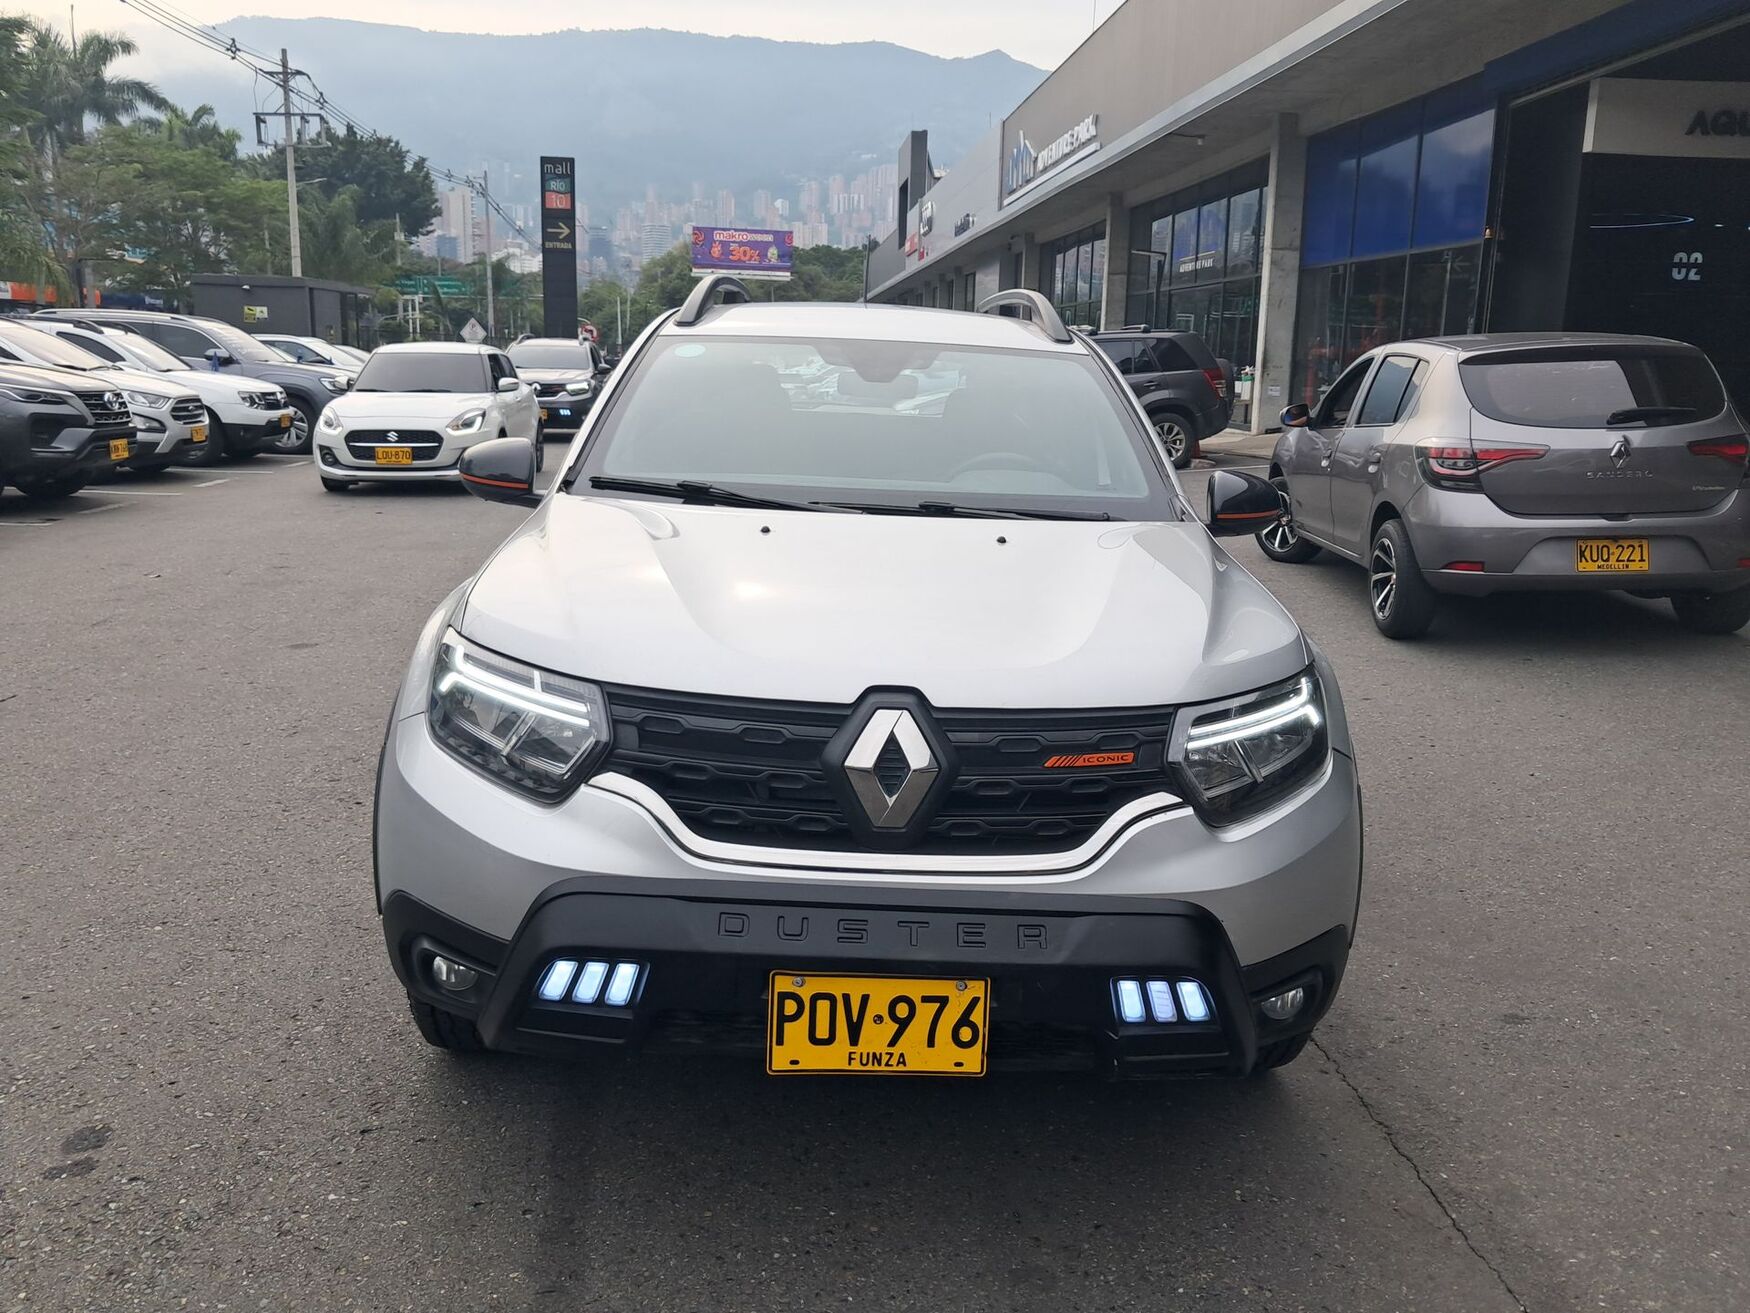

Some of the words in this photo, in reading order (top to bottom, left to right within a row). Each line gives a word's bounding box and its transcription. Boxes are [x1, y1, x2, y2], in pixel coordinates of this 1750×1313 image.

[544, 162, 571, 175] mall
[551, 194, 566, 209] 10
[713, 230, 750, 242] makro
[545, 241, 573, 249] ENTRADA
[729, 246, 761, 263] 30%
[1671, 252, 1703, 281] 02
[1082, 754, 1129, 764] ICONIC
[717, 911, 1048, 950] DUSTER
[847, 1051, 907, 1067] FUNZA
